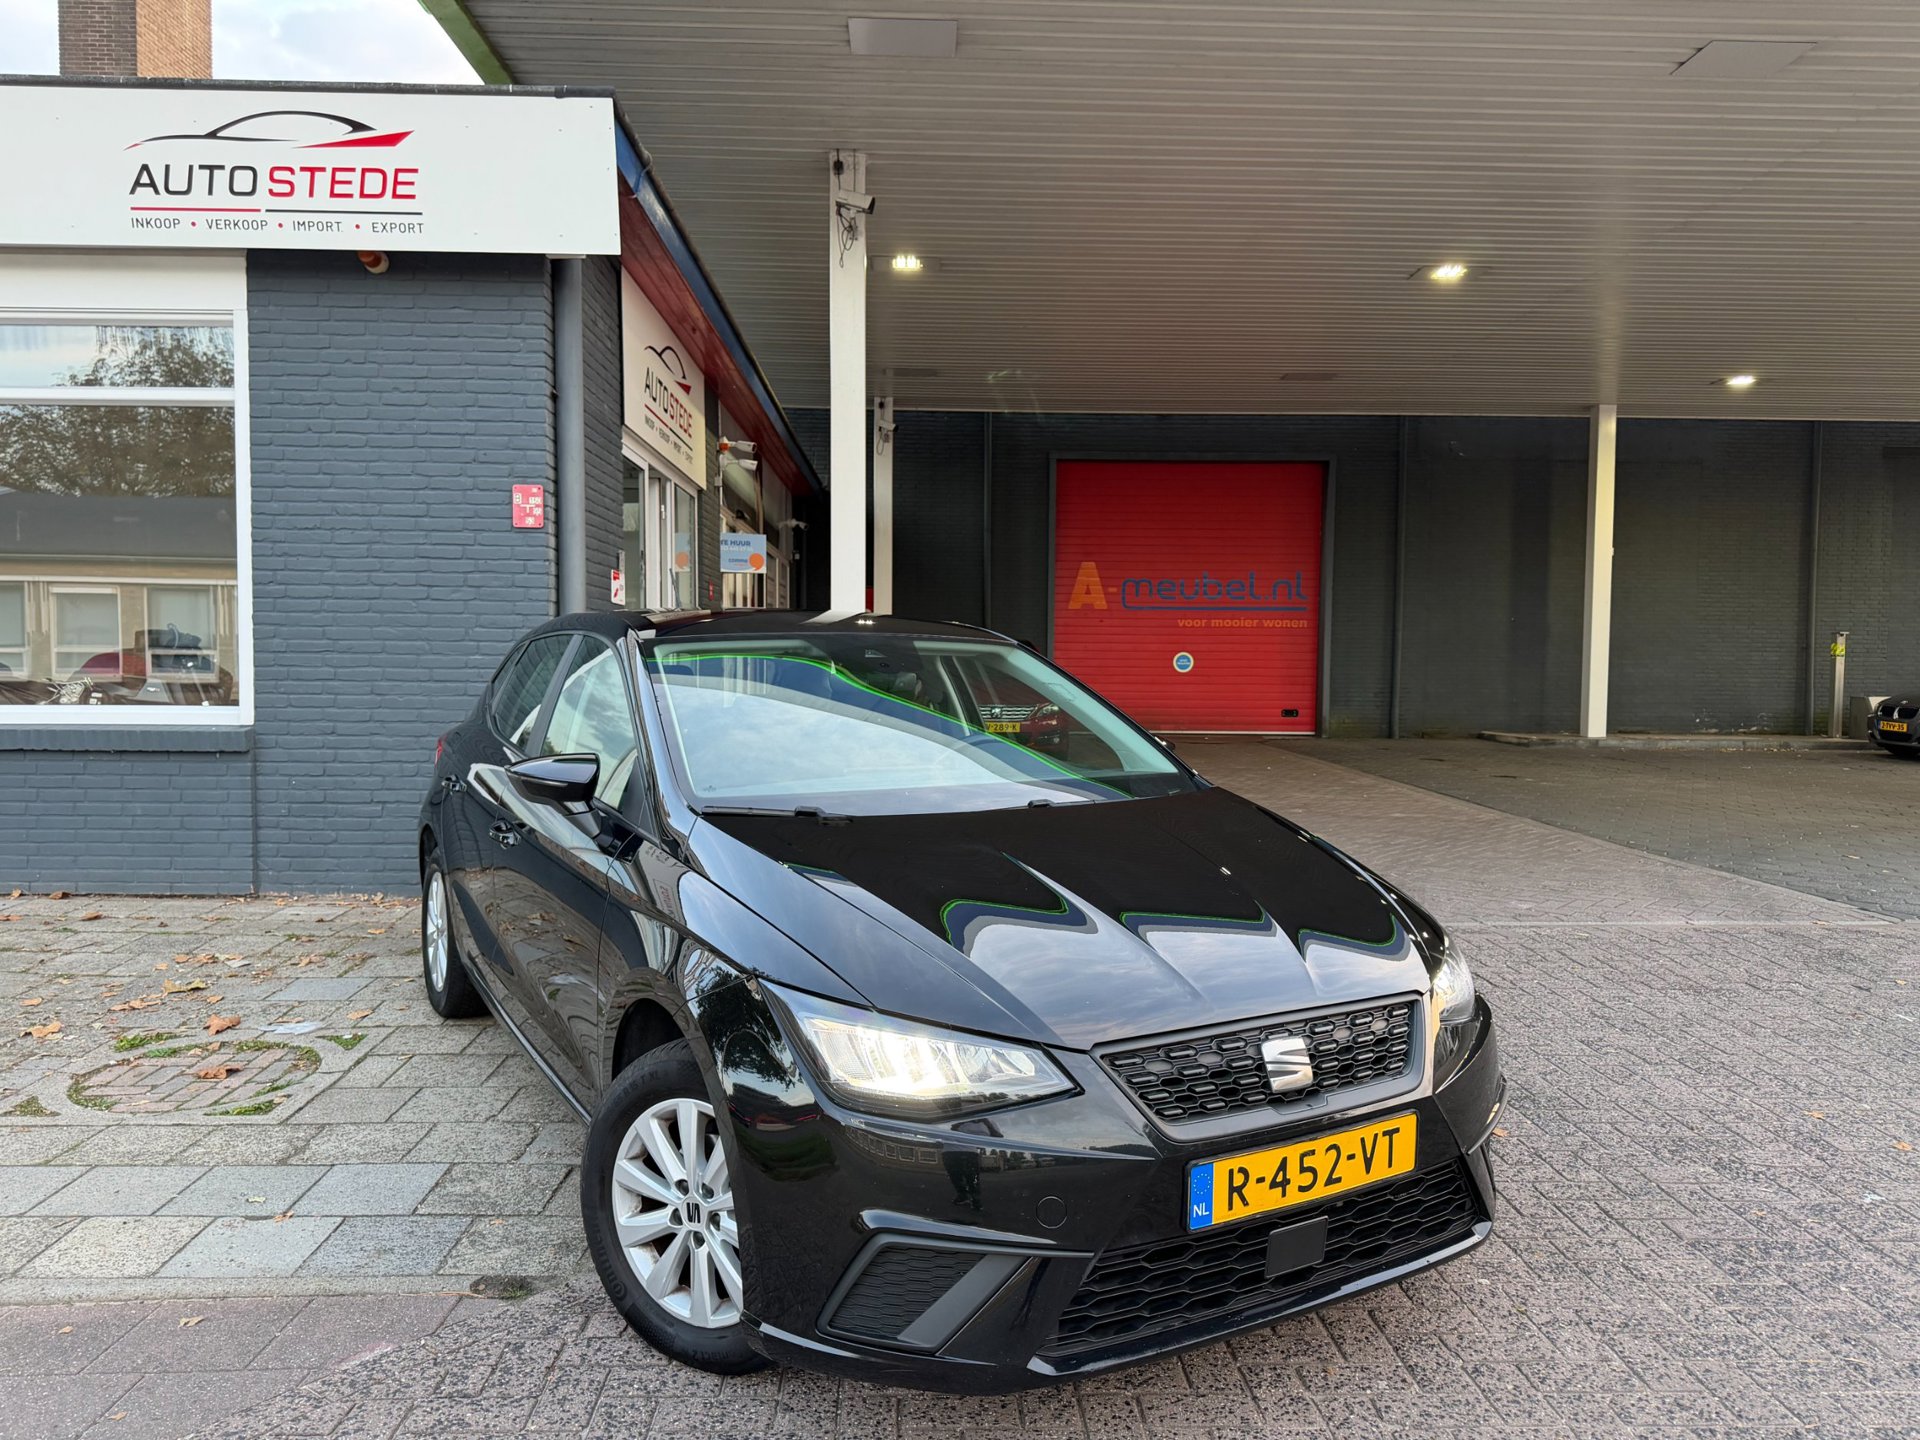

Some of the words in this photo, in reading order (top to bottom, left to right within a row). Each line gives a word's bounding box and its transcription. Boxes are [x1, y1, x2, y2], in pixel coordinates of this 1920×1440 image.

[131, 217, 181, 229] INKOOP
[205, 218, 268, 231] VERKOOP
[292, 220, 342, 233] IMPORT
[371, 221, 424, 234] EXPORT
[1177, 618, 1208, 628] voor
[1211, 617, 1259, 628] mooier
[1262, 618, 1308, 629] wonen
[1227, 1127, 1400, 1211] R-452-VT
[1193, 1202, 1210, 1218] NL
